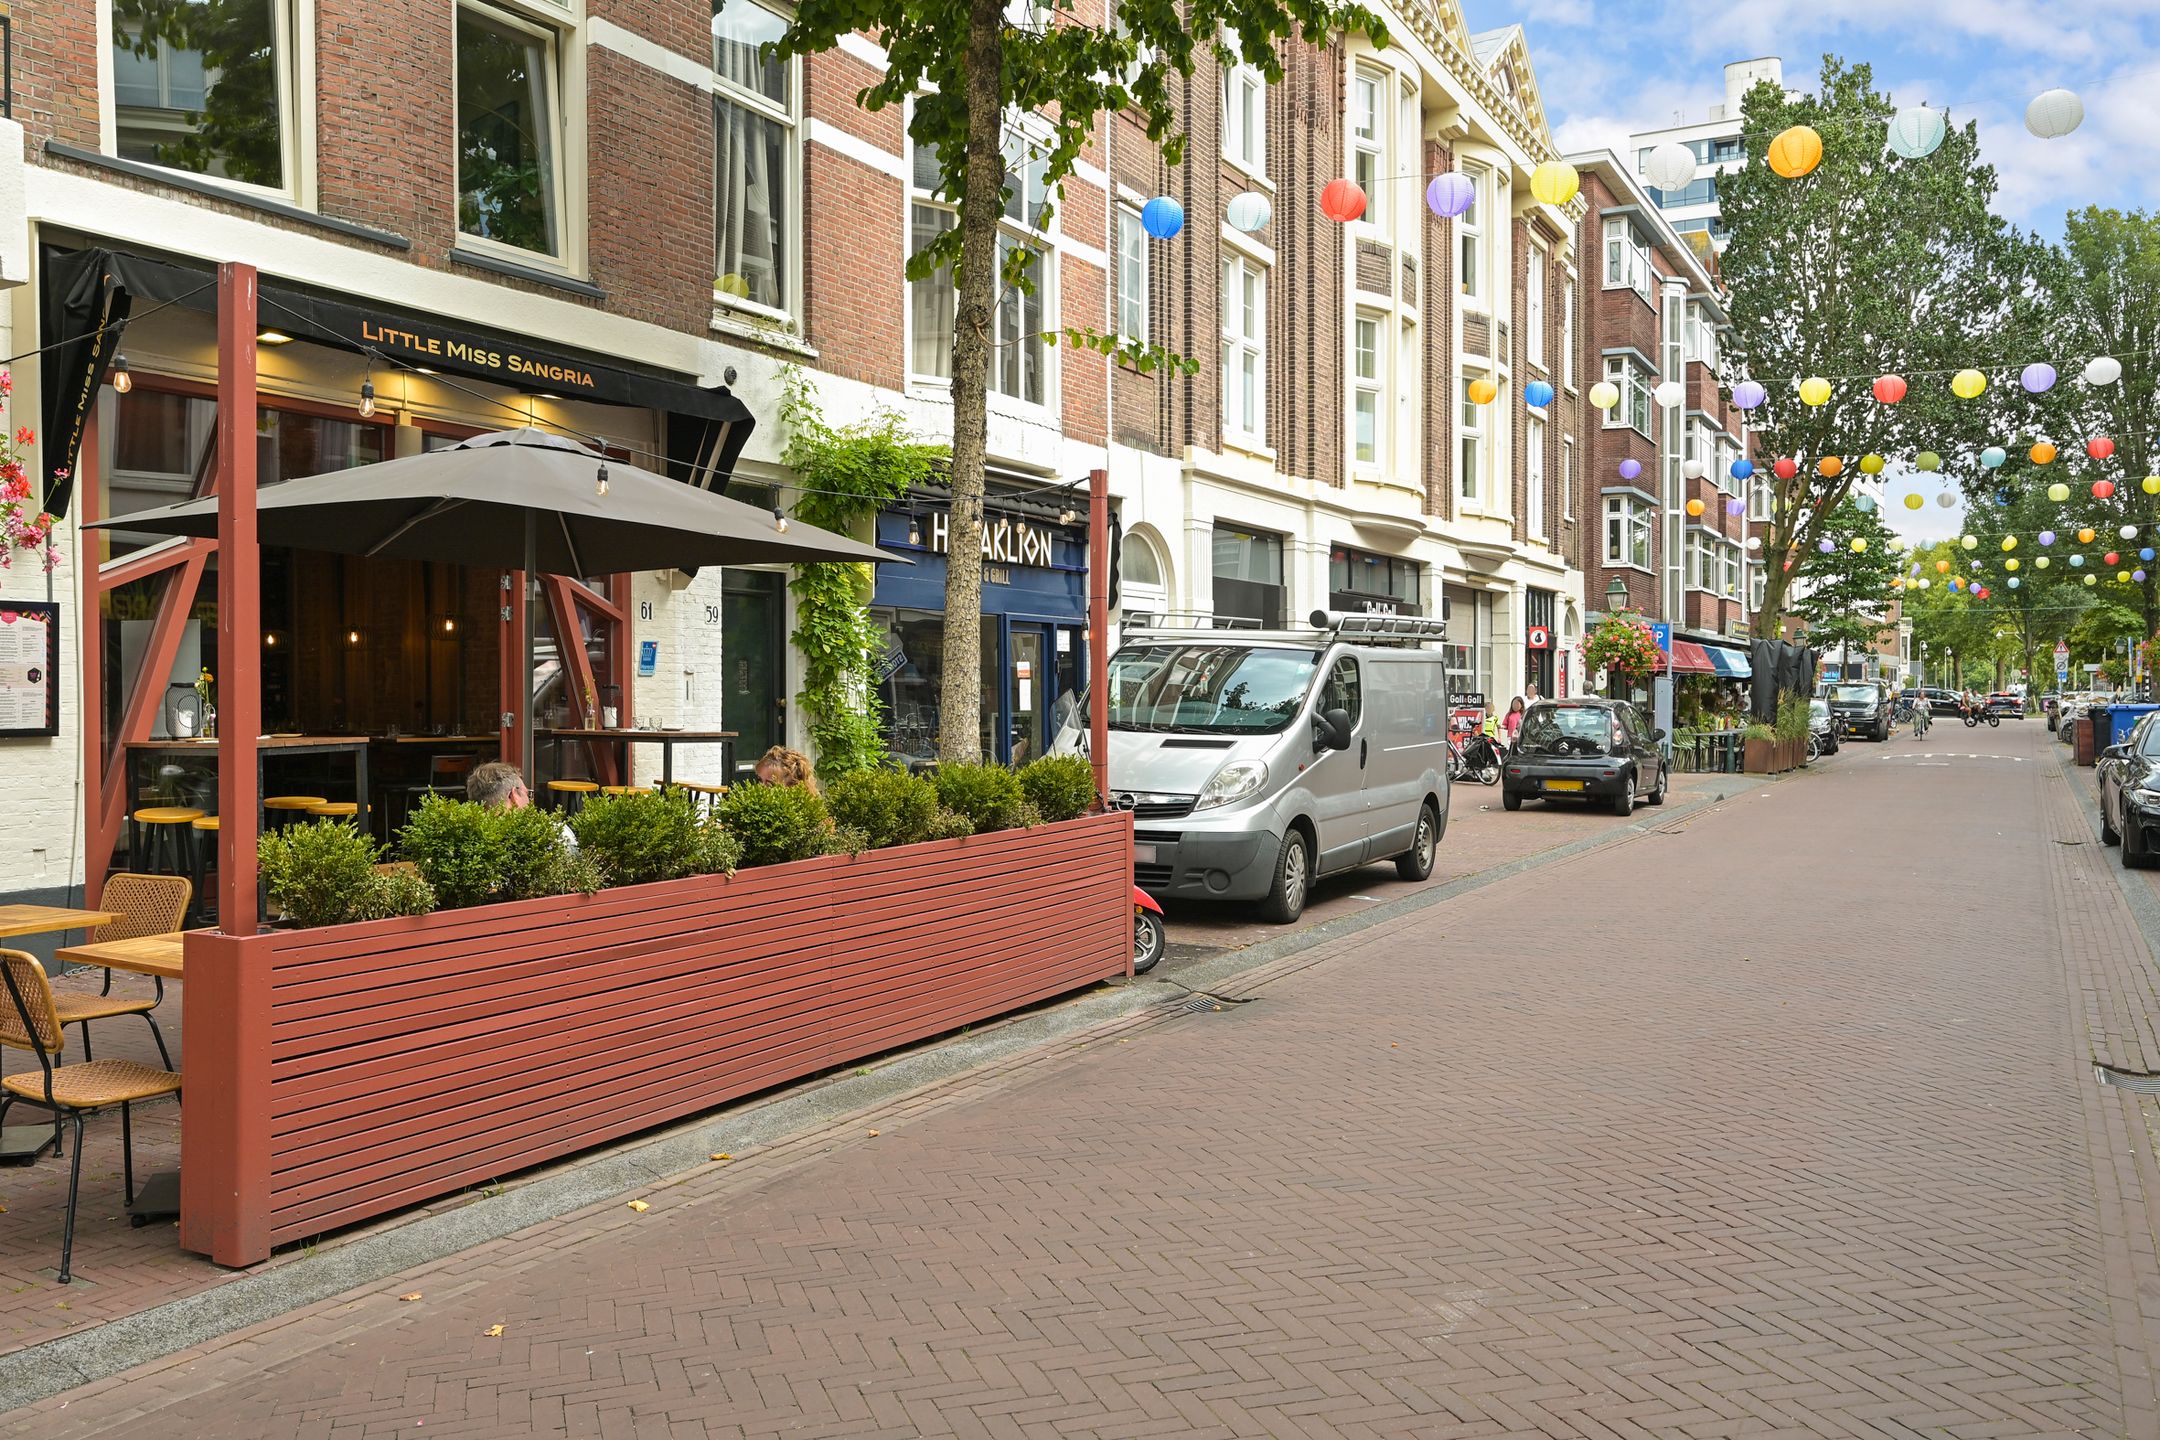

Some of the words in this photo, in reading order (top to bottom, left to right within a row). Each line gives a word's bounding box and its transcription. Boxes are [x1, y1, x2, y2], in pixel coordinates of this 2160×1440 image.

[362, 321, 441, 355] LITTLE
[447, 340, 501, 368] MISS
[507, 354, 595, 388] SANGRIA
[77, 362, 95, 411] MISS
[990, 568, 1011, 585] GRILL
[641, 601, 652, 620] 61
[706, 606, 719, 622] 59
